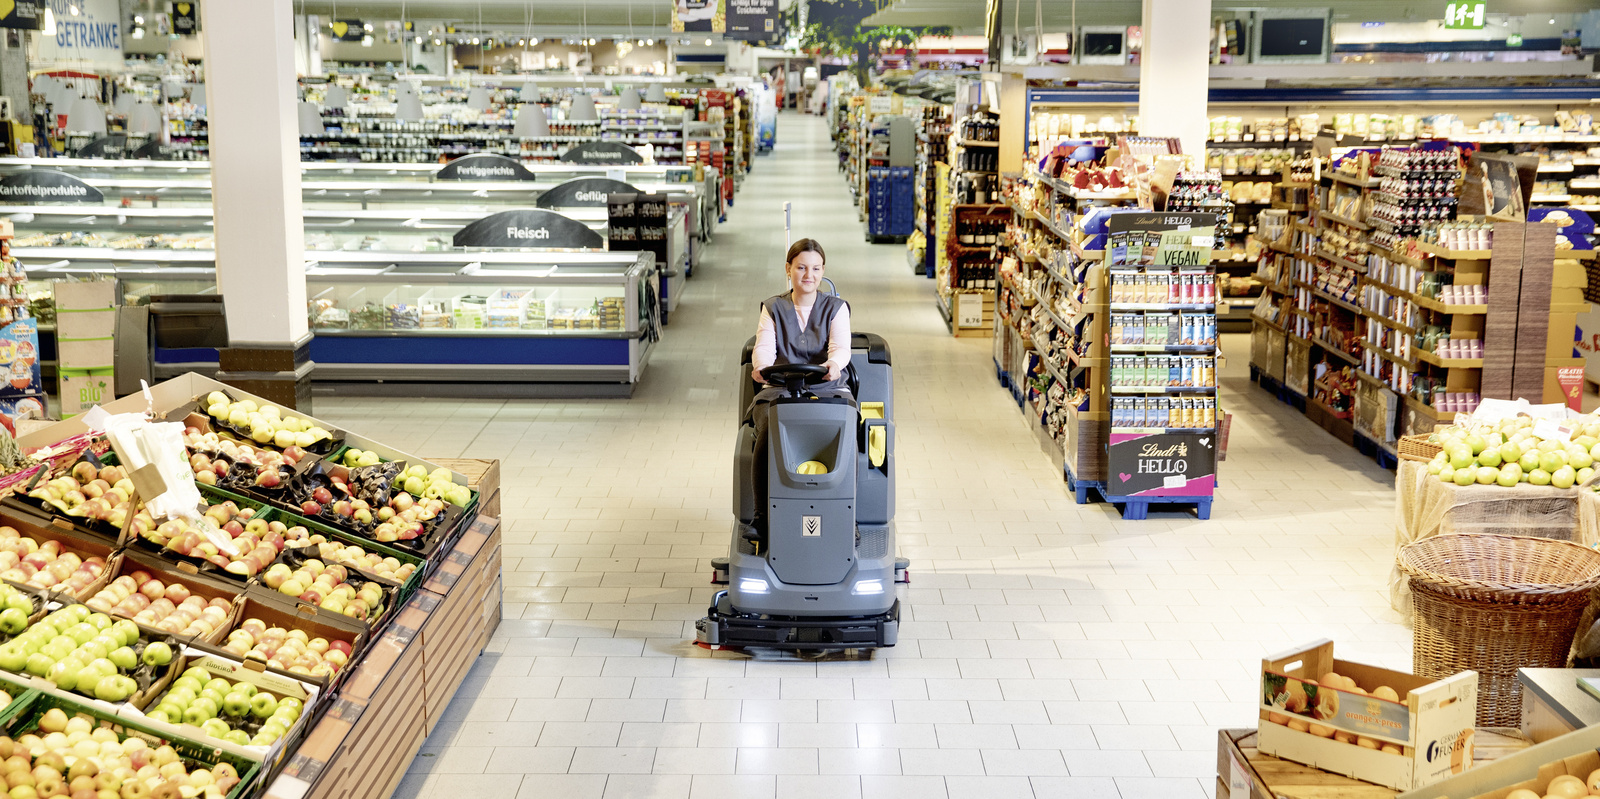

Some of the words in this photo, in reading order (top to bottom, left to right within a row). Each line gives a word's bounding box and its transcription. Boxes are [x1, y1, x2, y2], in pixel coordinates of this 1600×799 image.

[56, 15, 119, 49] GETRÄNKE
[582, 150, 622, 159] Backwaren
[457, 165, 515, 177] Fertiggerichte
[1134, 216, 1158, 225] Lindt
[1163, 216, 1192, 225] HELLO
[507, 226, 550, 239] Fleisch
[1166, 234, 1192, 245] HELL
[1164, 250, 1200, 265] VEGAN
[1138, 443, 1179, 457] Lindt
[1137, 459, 1188, 474] HELLO
[1439, 738, 1465, 758] FUSTER
